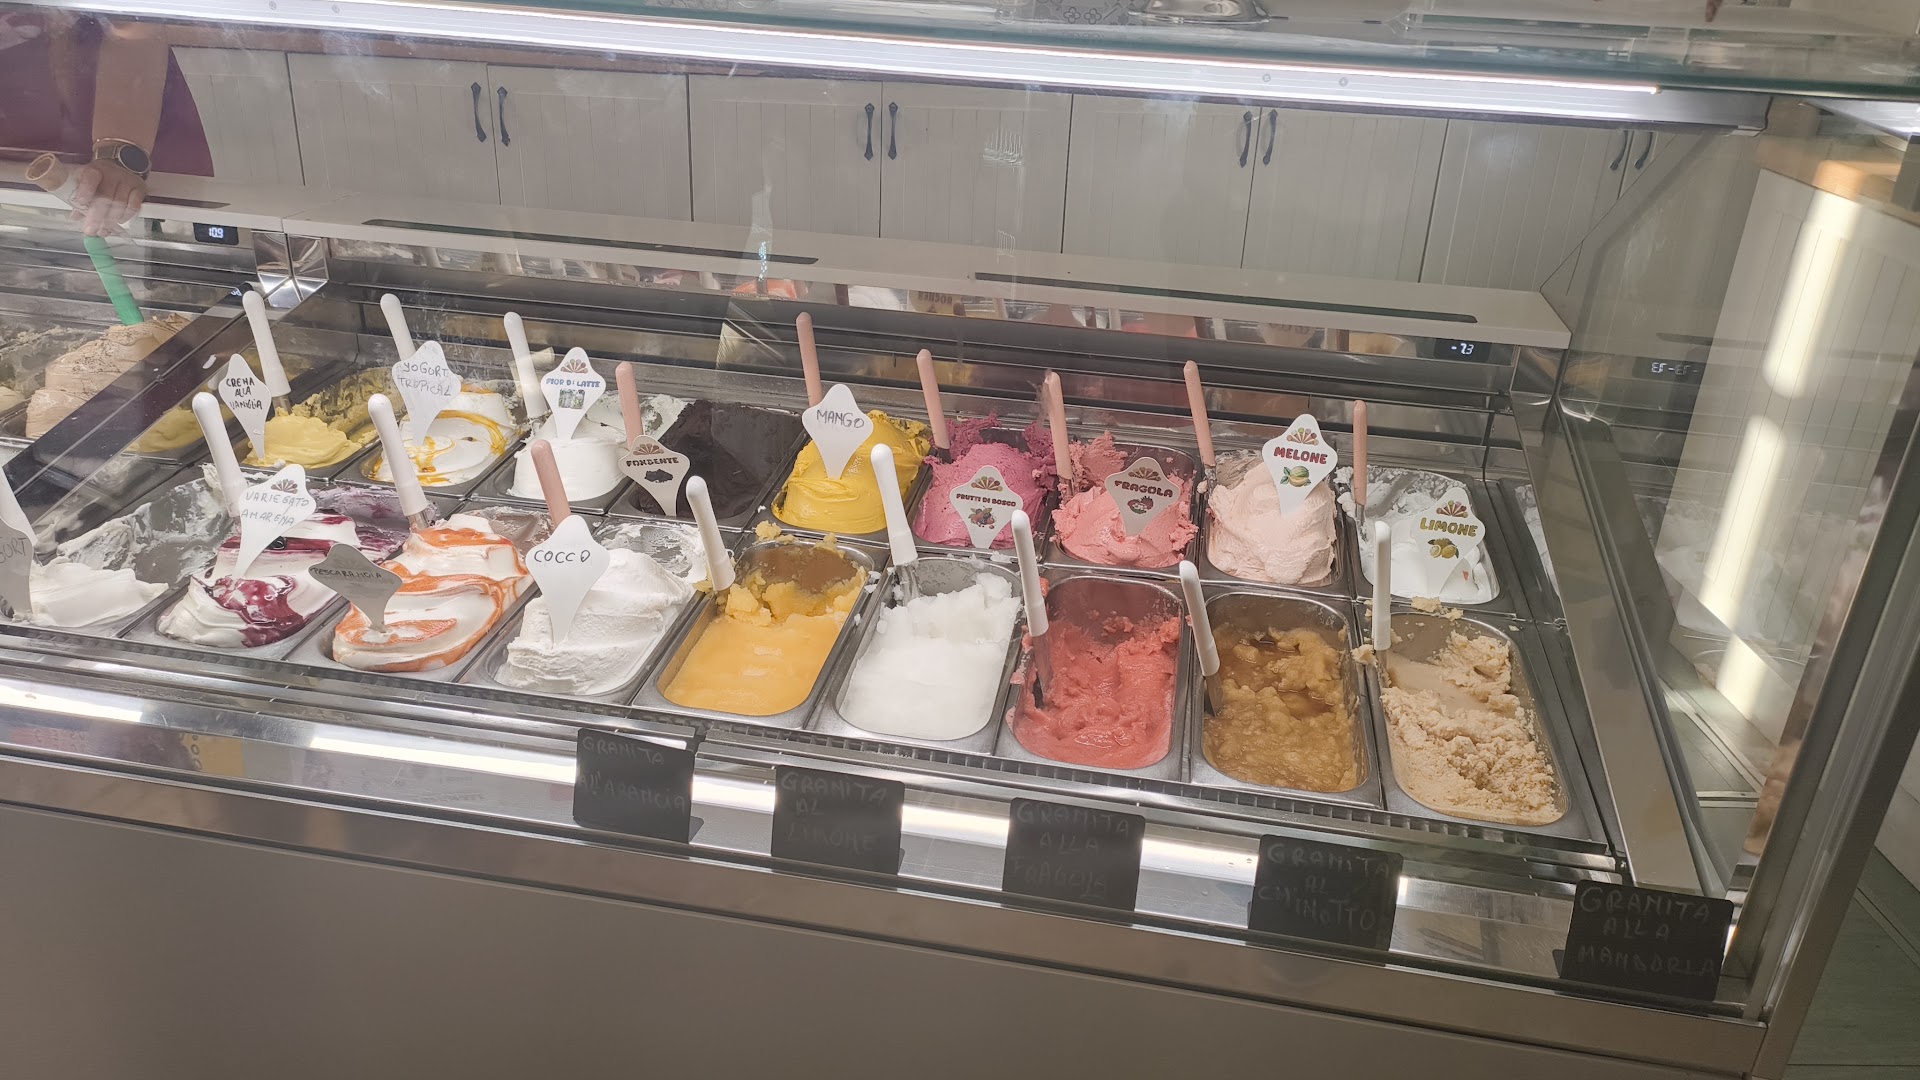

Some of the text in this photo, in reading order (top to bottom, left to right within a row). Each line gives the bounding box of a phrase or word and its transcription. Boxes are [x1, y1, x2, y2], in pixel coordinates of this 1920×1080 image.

[397, 377, 452, 396] TROPICAL
[545, 377, 564, 386] FIOR
[576, 380, 601, 388] LATTE
[816, 409, 865, 429] MANGO
[625, 457, 680, 467] FONDENTE
[1273, 446, 1328, 465] MELONE
[1114, 480, 1174, 498] FRAGOLA
[956, 493, 981, 502] FRUTTI
[991, 498, 1017, 507] BOSCO
[241, 508, 295, 527] AMARENA
[1420, 517, 1478, 537] LIMONE
[534, 549, 591, 564] COCCO
[582, 735, 665, 766] GRANITA
[780, 771, 888, 807] GRANITA
[795, 798, 824, 816] AL
[1016, 801, 1130, 838] GRANITA
[1039, 831, 1099, 855] ALLA
[1267, 842, 1389, 880] GRANITA
[1579, 886, 1711, 922] GRANITA
[1602, 917, 1670, 941] ALLA
